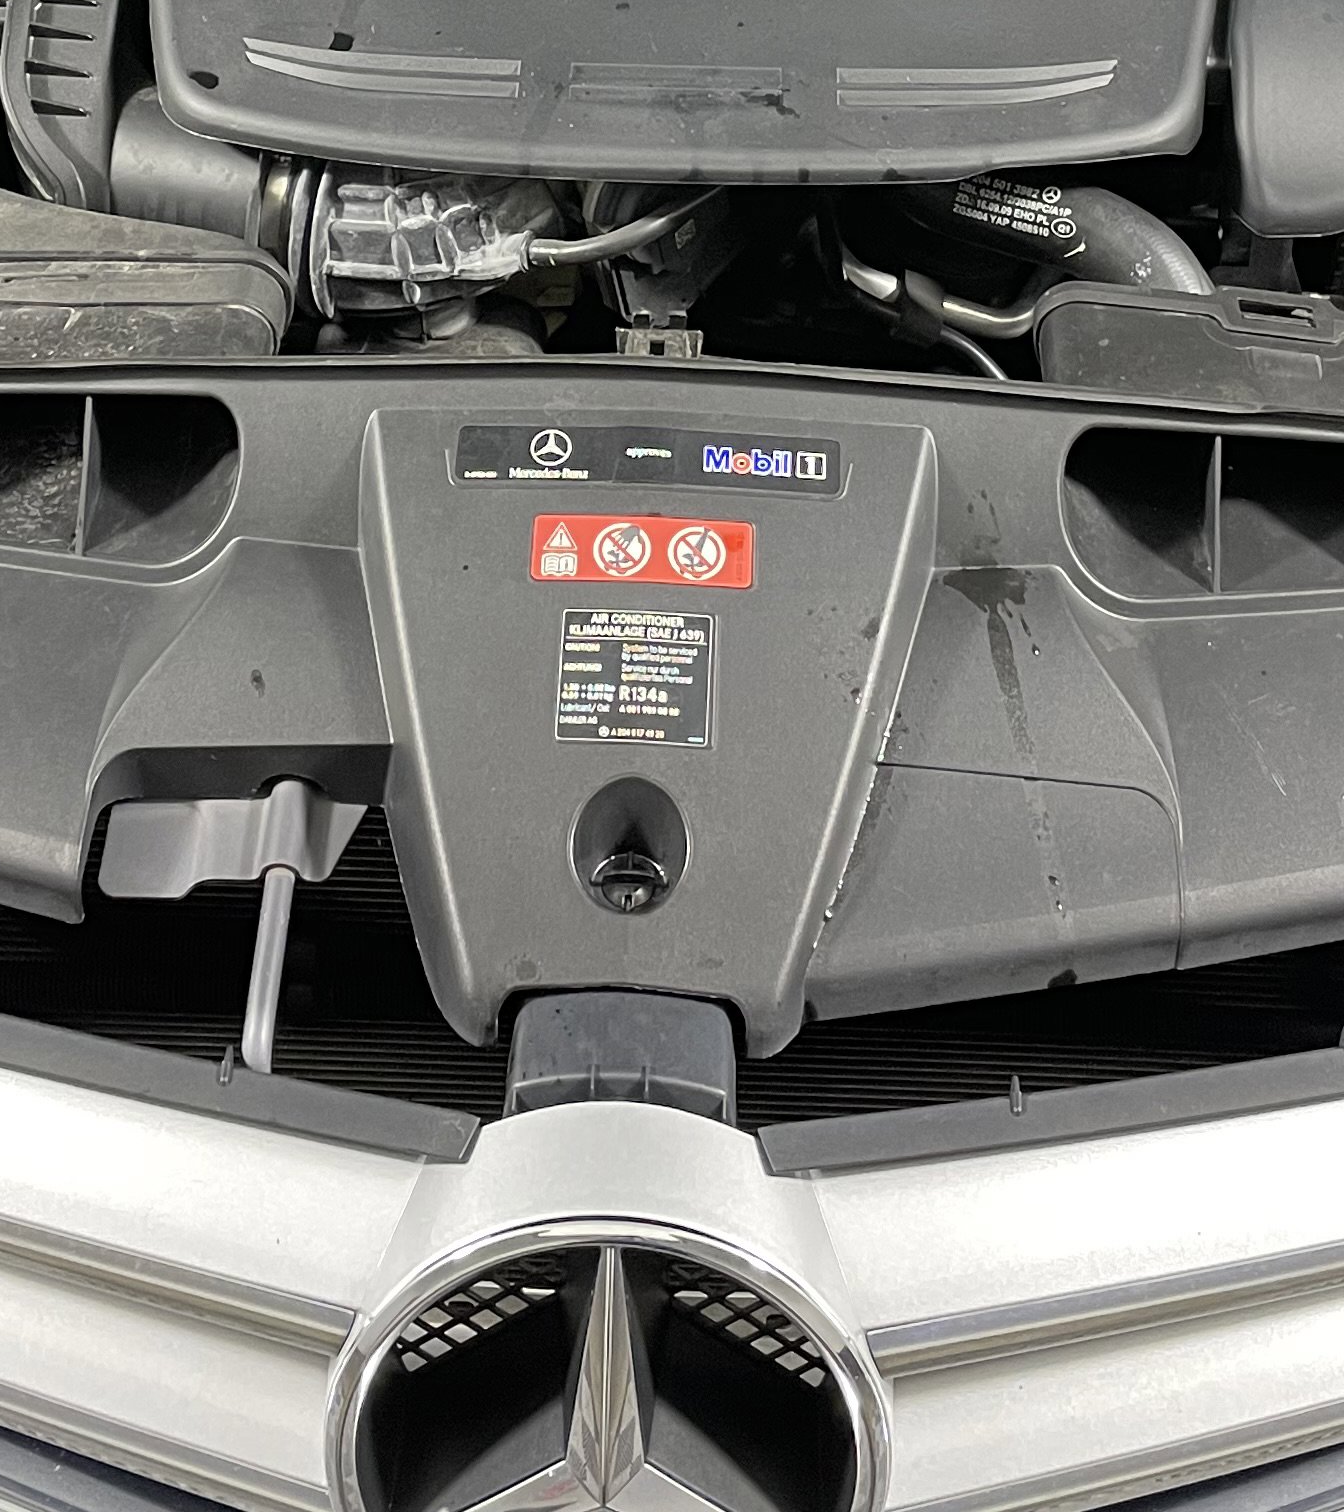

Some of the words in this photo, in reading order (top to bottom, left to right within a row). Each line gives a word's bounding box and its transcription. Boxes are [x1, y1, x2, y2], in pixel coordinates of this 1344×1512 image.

[989, 214, 1010, 226] YAP
[1037, 214, 1049, 226] PL
[703, 445, 792, 478] Mobil
[509, 467, 588, 479] Mercedes-Benz
[590, 613, 609, 624] AIR
[610, 614, 684, 628] CONDITIONER
[568, 624, 646, 638] KLIMAANLAGE
[647, 627, 672, 640] (SAE
[679, 629, 705, 643] 639)
[650, 645, 657, 653] to
[658, 646, 667, 654] be
[622, 652, 631, 661] by
[618, 685, 668, 703] R134a
